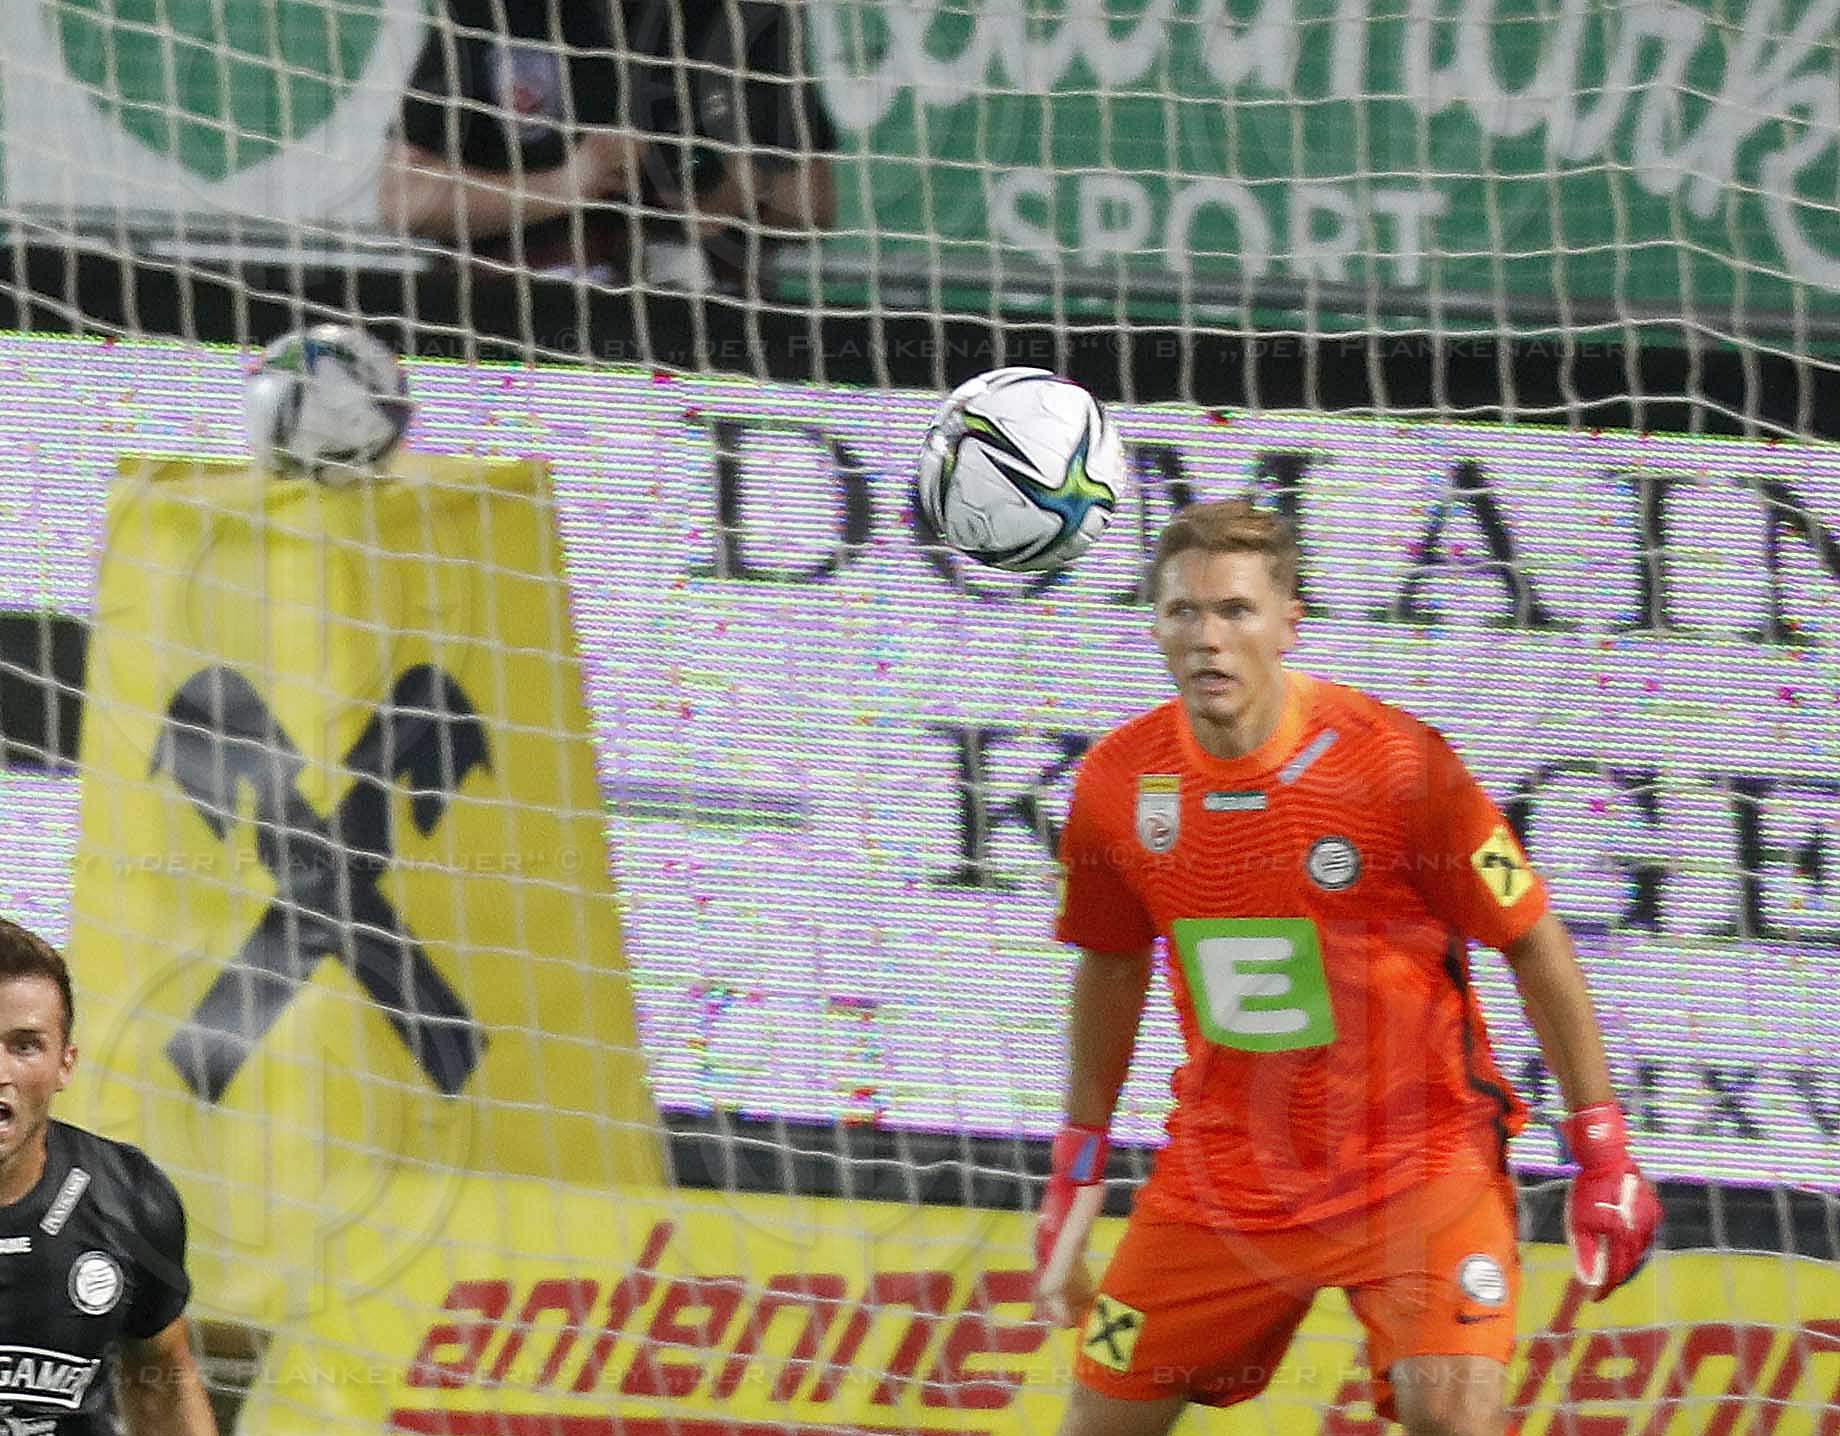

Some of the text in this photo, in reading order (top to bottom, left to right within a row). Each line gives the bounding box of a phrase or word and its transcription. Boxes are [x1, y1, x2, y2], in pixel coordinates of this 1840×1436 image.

[987, 168, 1449, 285] SPORT
[1196, 937, 1309, 1034] E
[407, 1221, 1051, 1409] antenne
